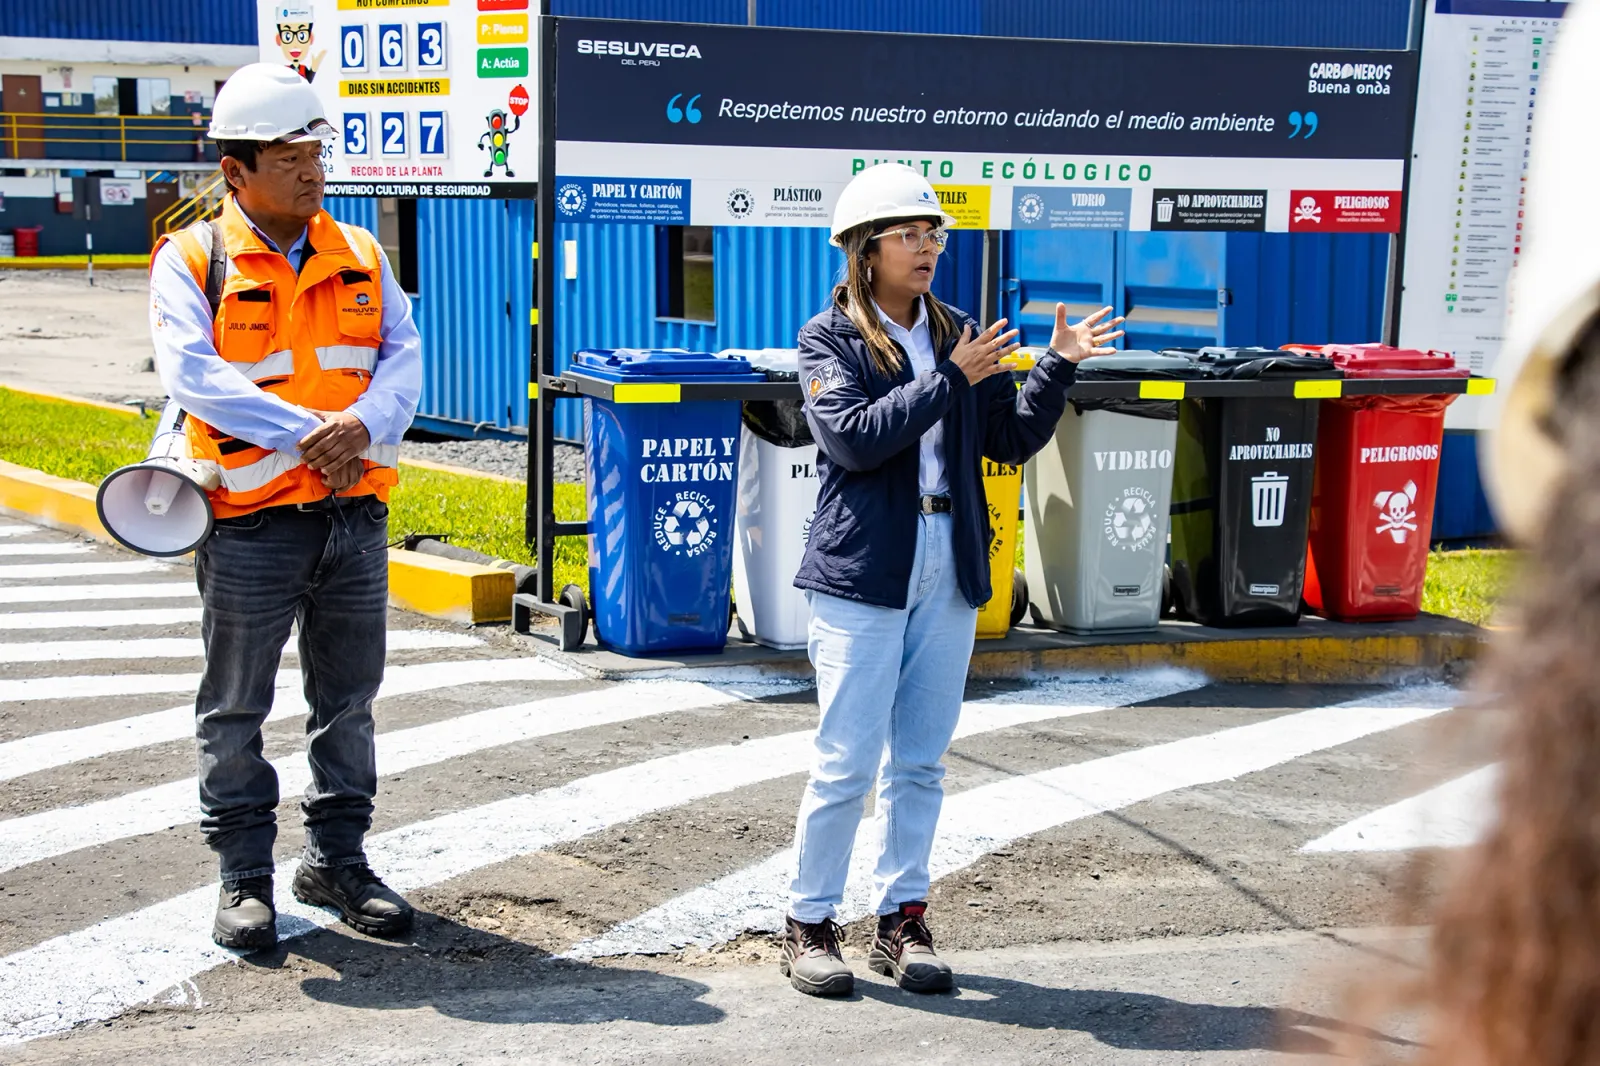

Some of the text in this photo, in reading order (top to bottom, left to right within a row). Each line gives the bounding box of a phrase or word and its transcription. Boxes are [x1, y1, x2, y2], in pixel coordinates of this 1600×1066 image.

[577, 40, 702, 58] SESUVECA
[482, 57, 520, 68] A: Actúa
[349, 82, 440, 95] DIAS SIN ACCIDENTES
[1308, 80, 1350, 94] Buena
[510, 96, 529, 106] STOP
[719, 98, 844, 122] Respetemos
[850, 105, 926, 124] nuestro
[932, 107, 1008, 126] entorno
[1014, 108, 1100, 128] cuidando
[1105, 110, 1124, 128] el
[1127, 112, 1185, 130] medio
[1190, 113, 1275, 132] ambiente
[352, 166, 443, 176] RECORD DE LA PLANTA
[852, 157, 1152, 182] PTO ECÓLOGICO
[324, 184, 490, 196] MOVIENDO CULTURA DE SEGURIDAD
[592, 182, 682, 200] PAPEL Y CARTÓN
[774, 186, 822, 202] PLÁSTICO
[936, 192, 968, 204] TALES
[1072, 193, 1106, 206] VIDRIO
[1177, 194, 1264, 208] NO APROVECHABLES
[1334, 196, 1390, 209] PELIGROSOS
[1266, 427, 1280, 442] NO
[642, 438, 735, 458] PAPEL Y
[1229, 444, 1313, 460] APROVECHABLES
[1360, 444, 1438, 464] PELIGROSOS
[1094, 450, 1172, 471] VIDRIO
[640, 458, 734, 483] CARTÓN
[676, 491, 715, 513] RECICLA
[1124, 487, 1156, 508] RECICLA
[654, 507, 671, 551] REDUCE
[1104, 503, 1118, 546] REDUCE
[686, 530, 717, 557] REUSA
[1131, 526, 1156, 552] REUSA
